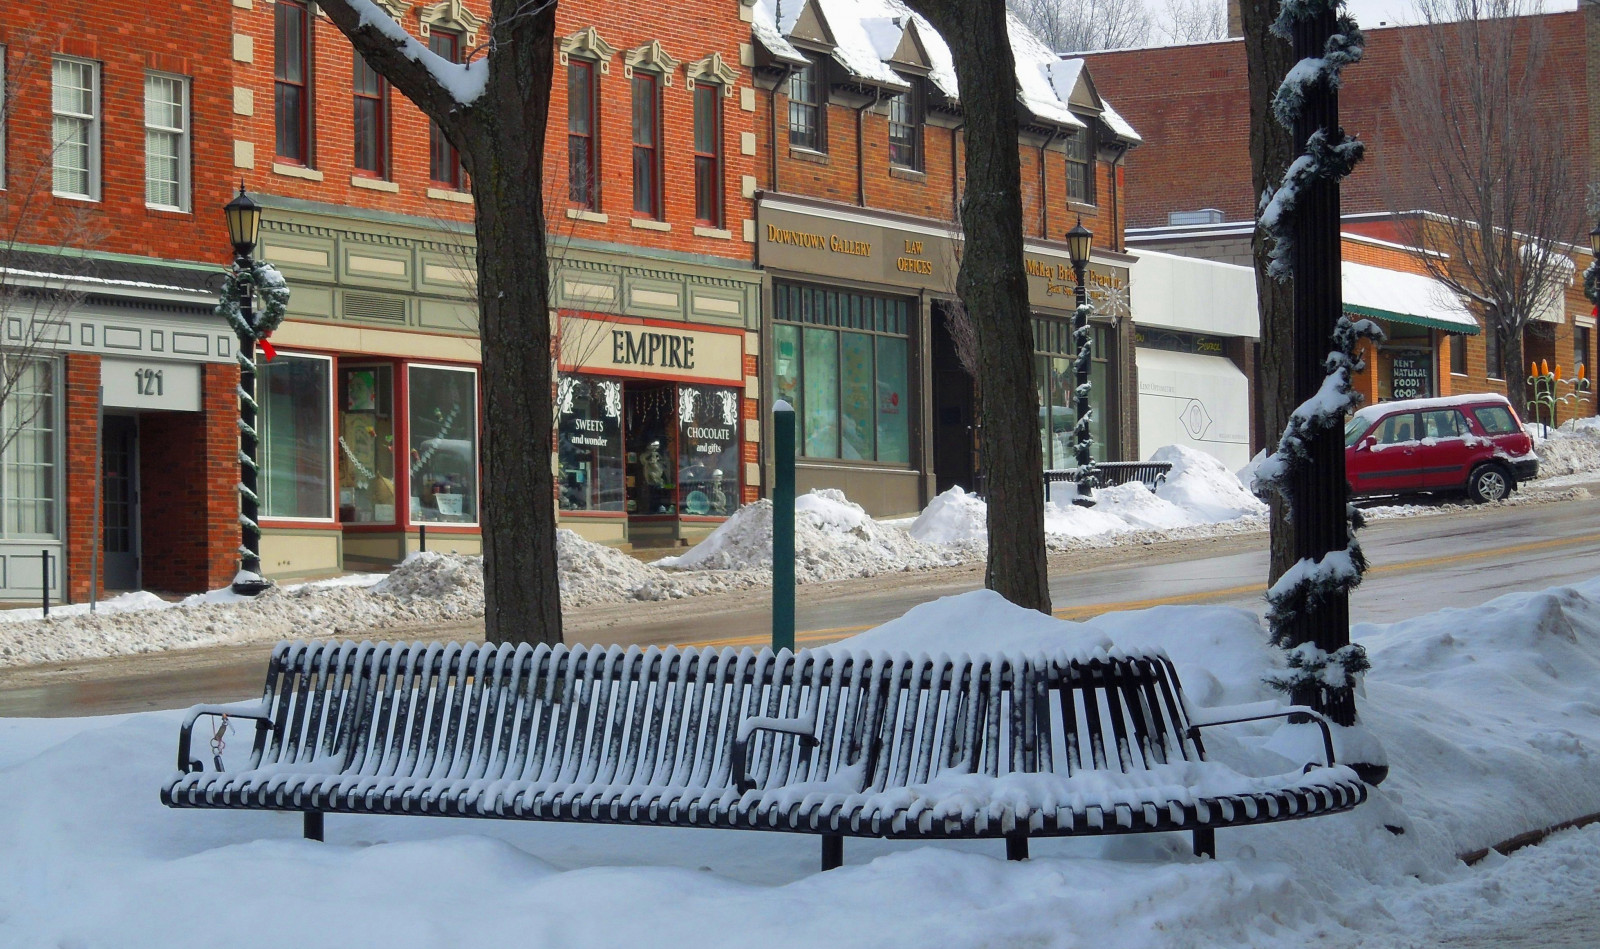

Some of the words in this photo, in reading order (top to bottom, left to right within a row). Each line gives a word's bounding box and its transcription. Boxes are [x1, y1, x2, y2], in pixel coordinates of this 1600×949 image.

[905, 240, 924, 255] LAW
[897, 257, 932, 275] OFFICES
[1026, 259, 1055, 281] McKay
[612, 330, 694, 369] EMPIRE
[1394, 359, 1415, 368] KENT
[1394, 368, 1427, 377] NATURAL
[135, 368, 163, 396] 121
[1394, 379, 1420, 387] FOODS
[1394, 389, 1416, 398] CO-OP
[575, 419, 604, 432] SWEETS
[687, 427, 730, 440] CHOCOLATE
[571, 435, 583, 445] and
[584, 436, 608, 446] wonder
[696, 443, 708, 453] and
[708, 443, 721, 454] gifts
